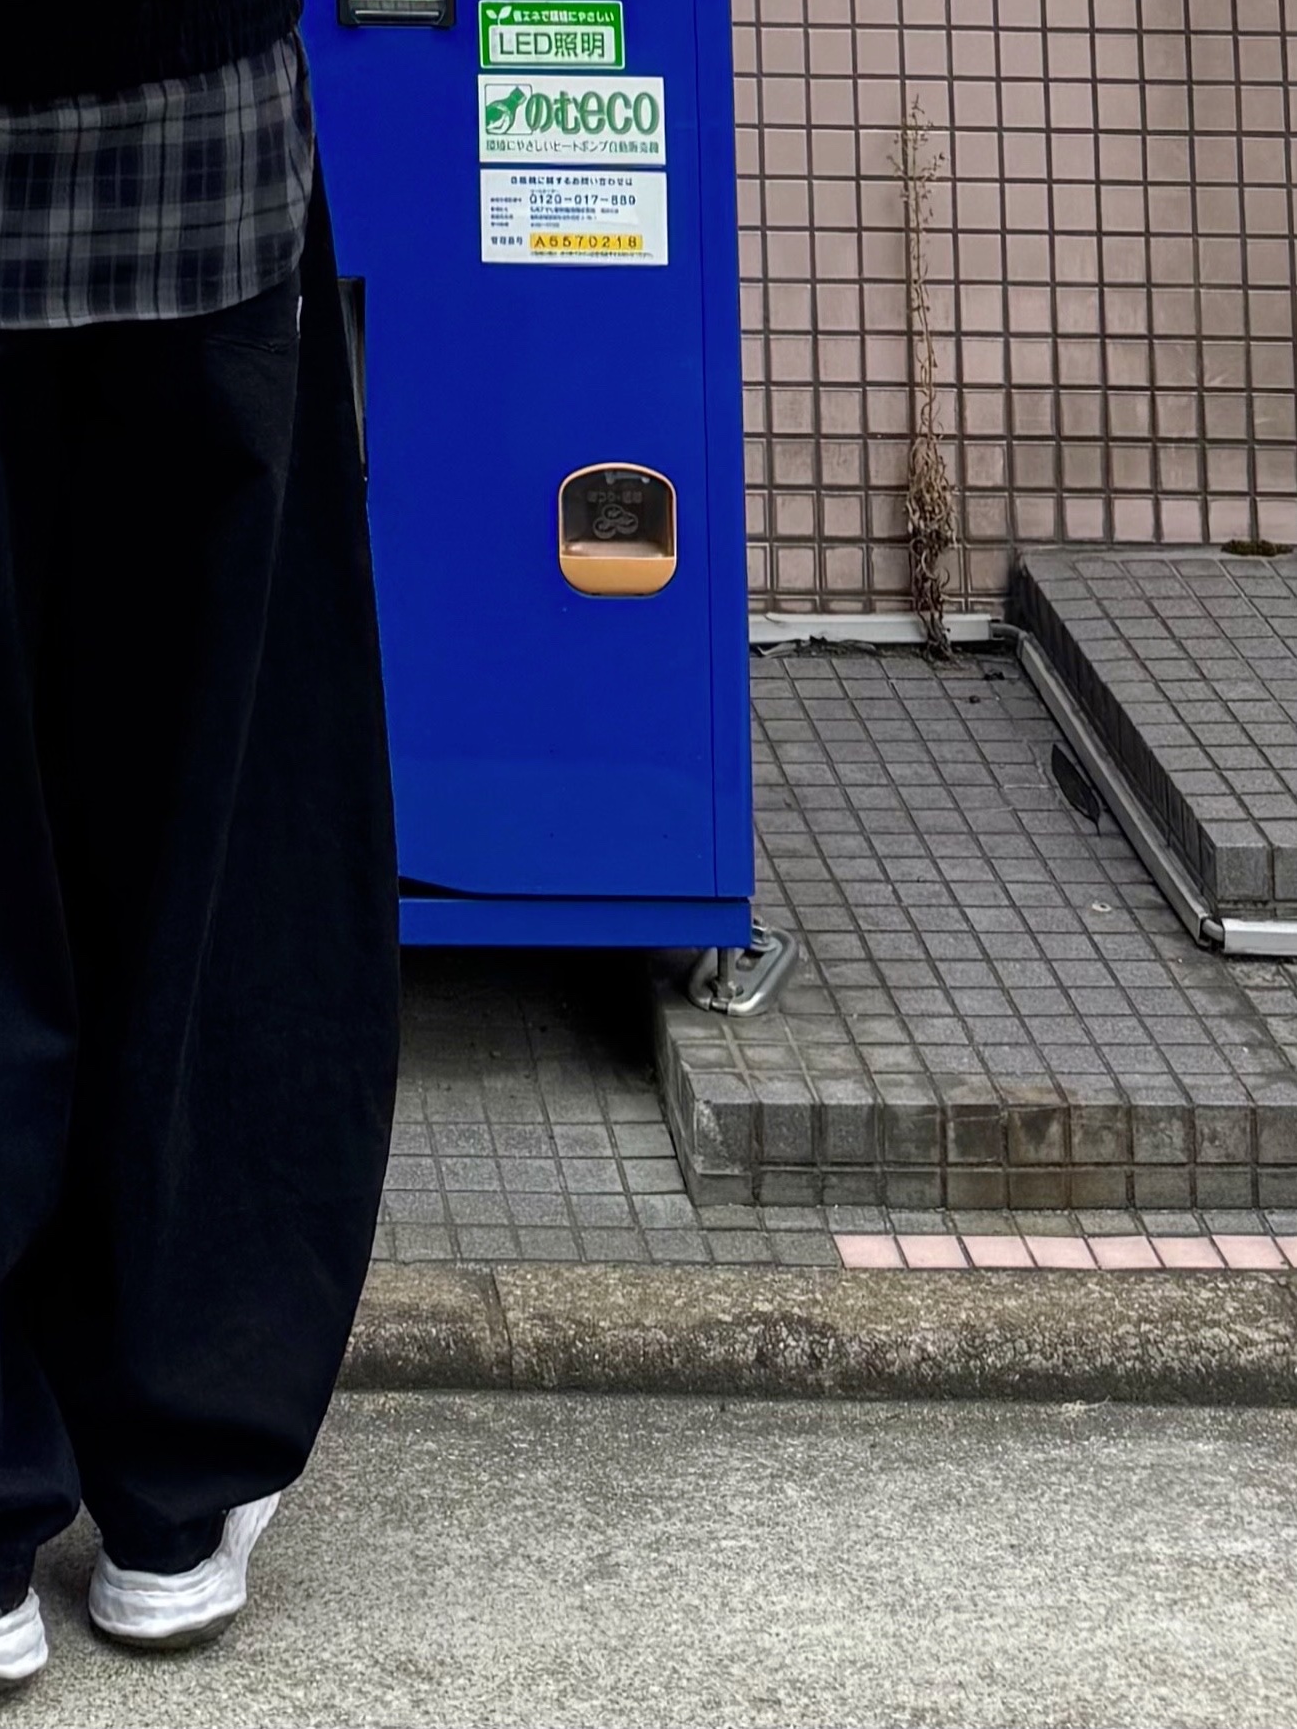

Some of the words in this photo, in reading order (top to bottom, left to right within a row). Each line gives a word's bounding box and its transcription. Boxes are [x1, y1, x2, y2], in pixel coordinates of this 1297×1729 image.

[513, 10, 615, 23] 省エネで環境にやさしい
[499, 31, 605, 58] LED照明
[525, 91, 660, 136] のむeco
[486, 139, 659, 154] 環境にやさしいヒートポンプ自動販売機
